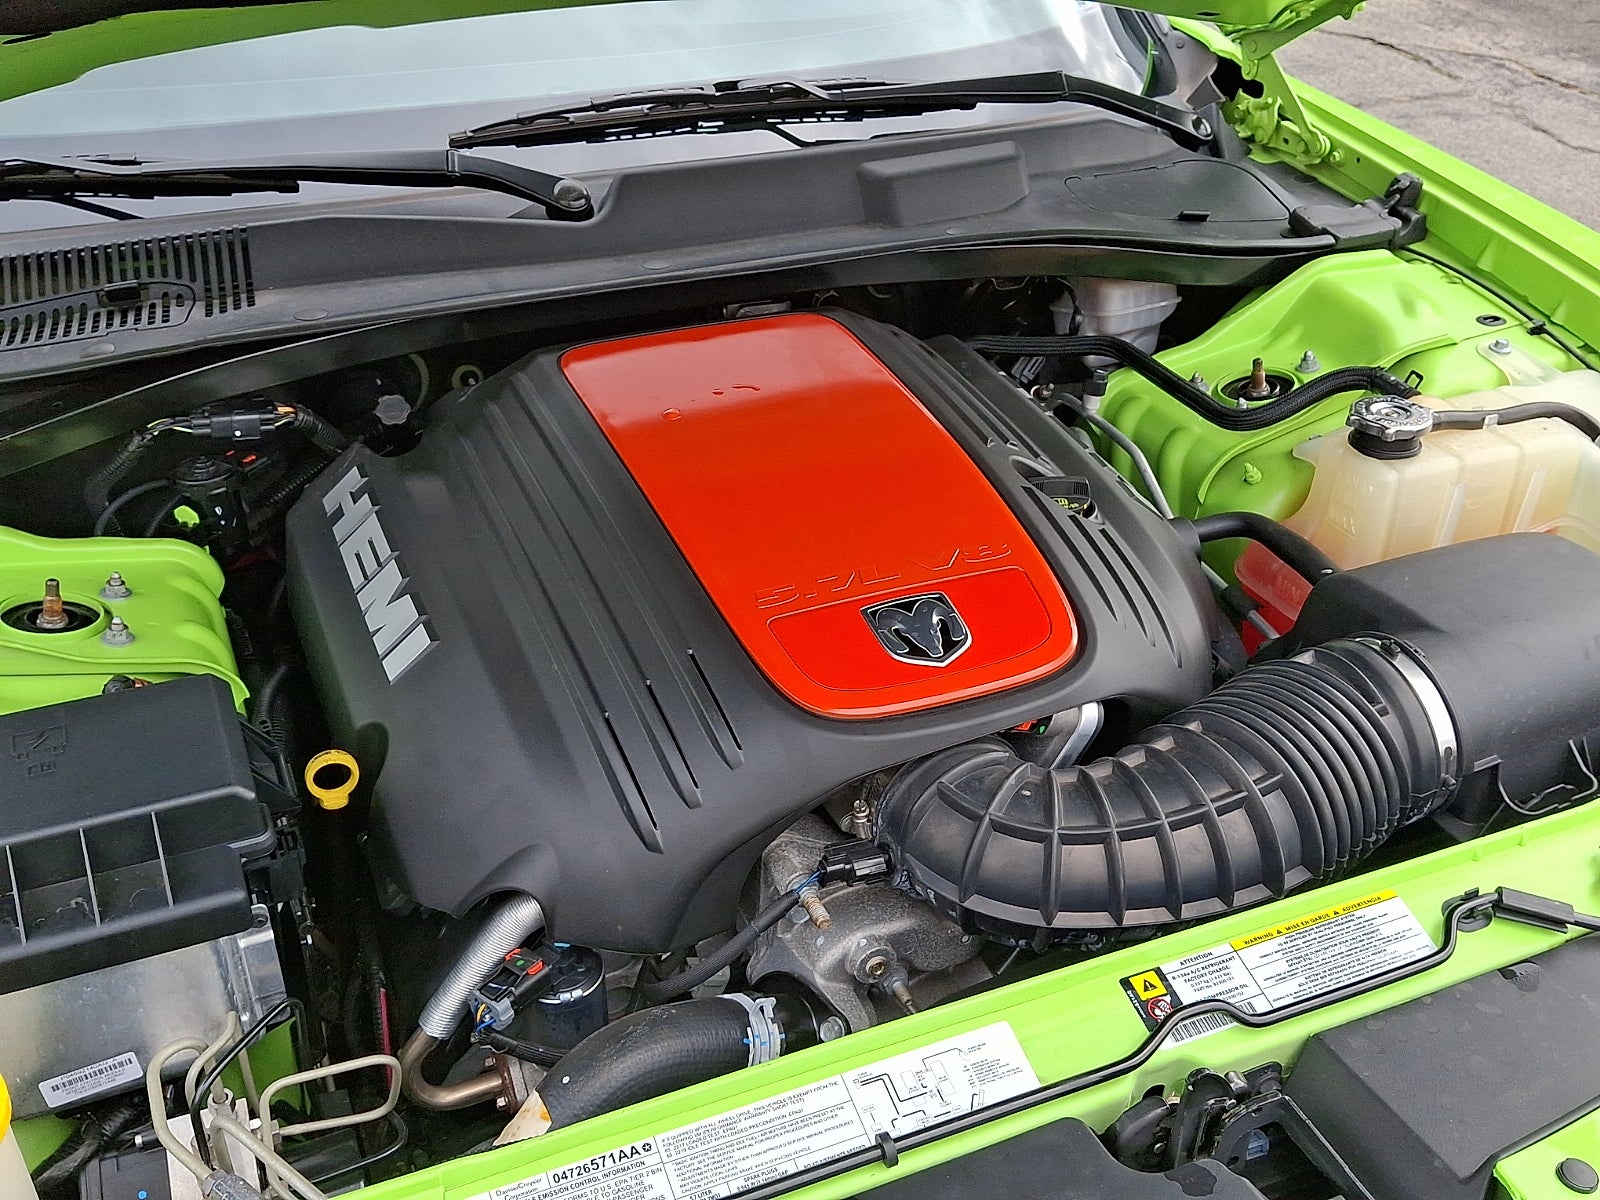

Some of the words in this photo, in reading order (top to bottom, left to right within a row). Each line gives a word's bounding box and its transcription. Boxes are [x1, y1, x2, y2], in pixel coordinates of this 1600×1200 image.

[322, 465, 438, 685] HEMI
[755, 564, 901, 610] 5.7L
[905, 543, 1012, 571] V8
[1243, 932, 1273, 945] WARNING
[1285, 923, 1300, 931] MISE
[1310, 913, 1330, 922] GARDE
[1180, 952, 1213, 966] ATTENTION
[1201, 956, 1235, 970] REFRIGERANT
[1184, 972, 1207, 983] FACTORY
[553, 1146, 641, 1183] 04726571AA
[538, 1186, 569, 1200] EMISSION
[570, 1176, 601, 1190] CONTROL
[602, 1161, 645, 1179] INFORMATION
[611, 1180, 645, 1195] GASOLINE
[614, 1179, 628, 1187] EPA
[629, 1173, 644, 1181] TIER
